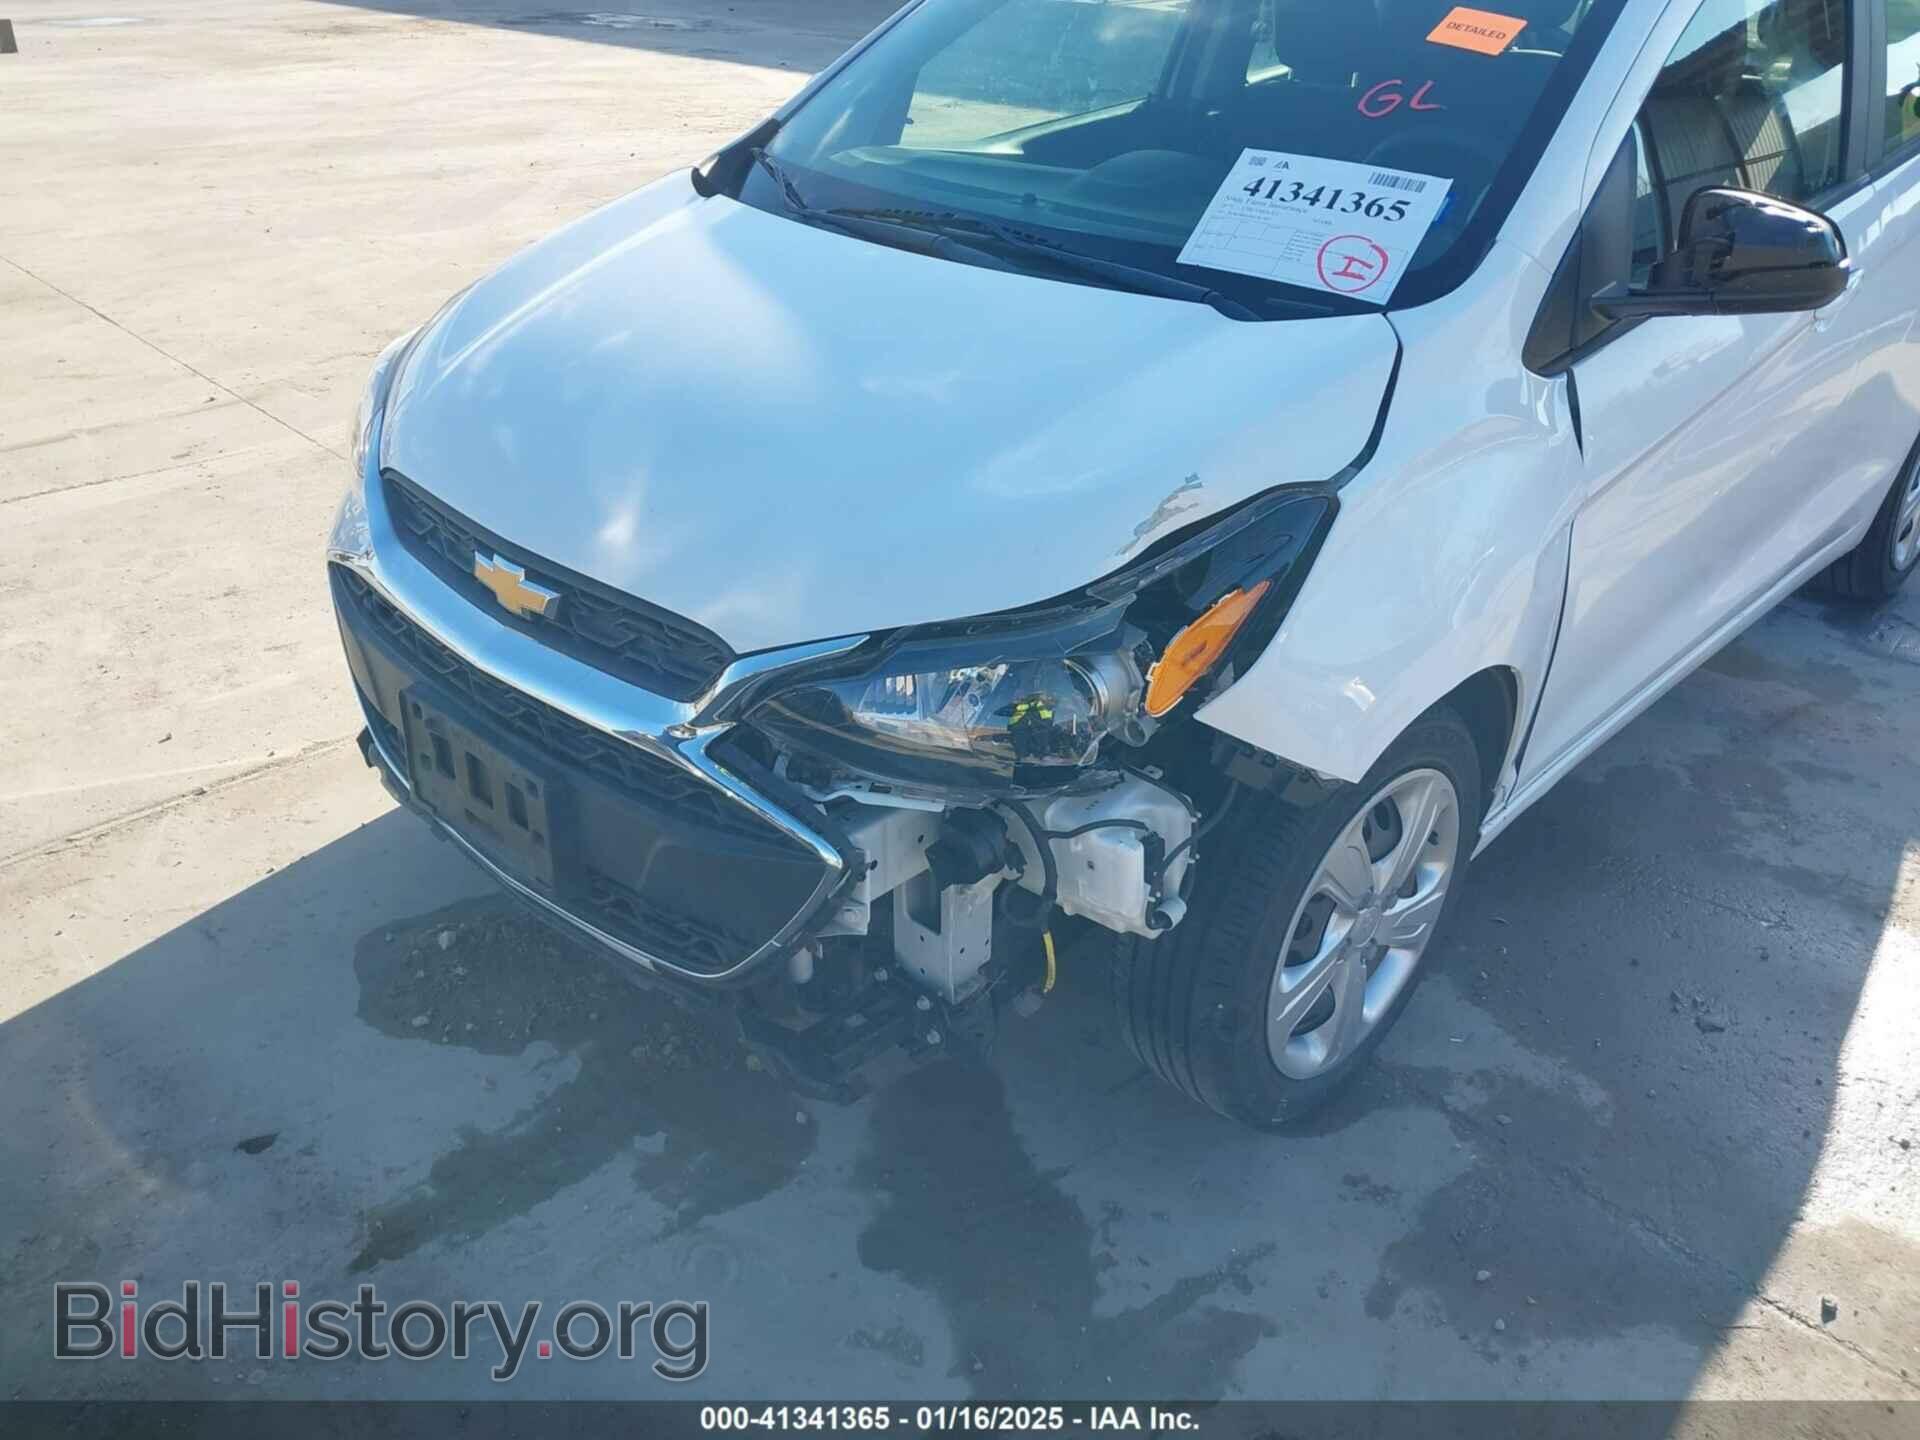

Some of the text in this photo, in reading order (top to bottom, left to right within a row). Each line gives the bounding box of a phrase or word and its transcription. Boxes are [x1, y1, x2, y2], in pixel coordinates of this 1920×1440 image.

[1446, 21, 1507, 40] DETAILED
[1357, 79, 1443, 118] GL
[1242, 176, 1412, 222] 41341365
